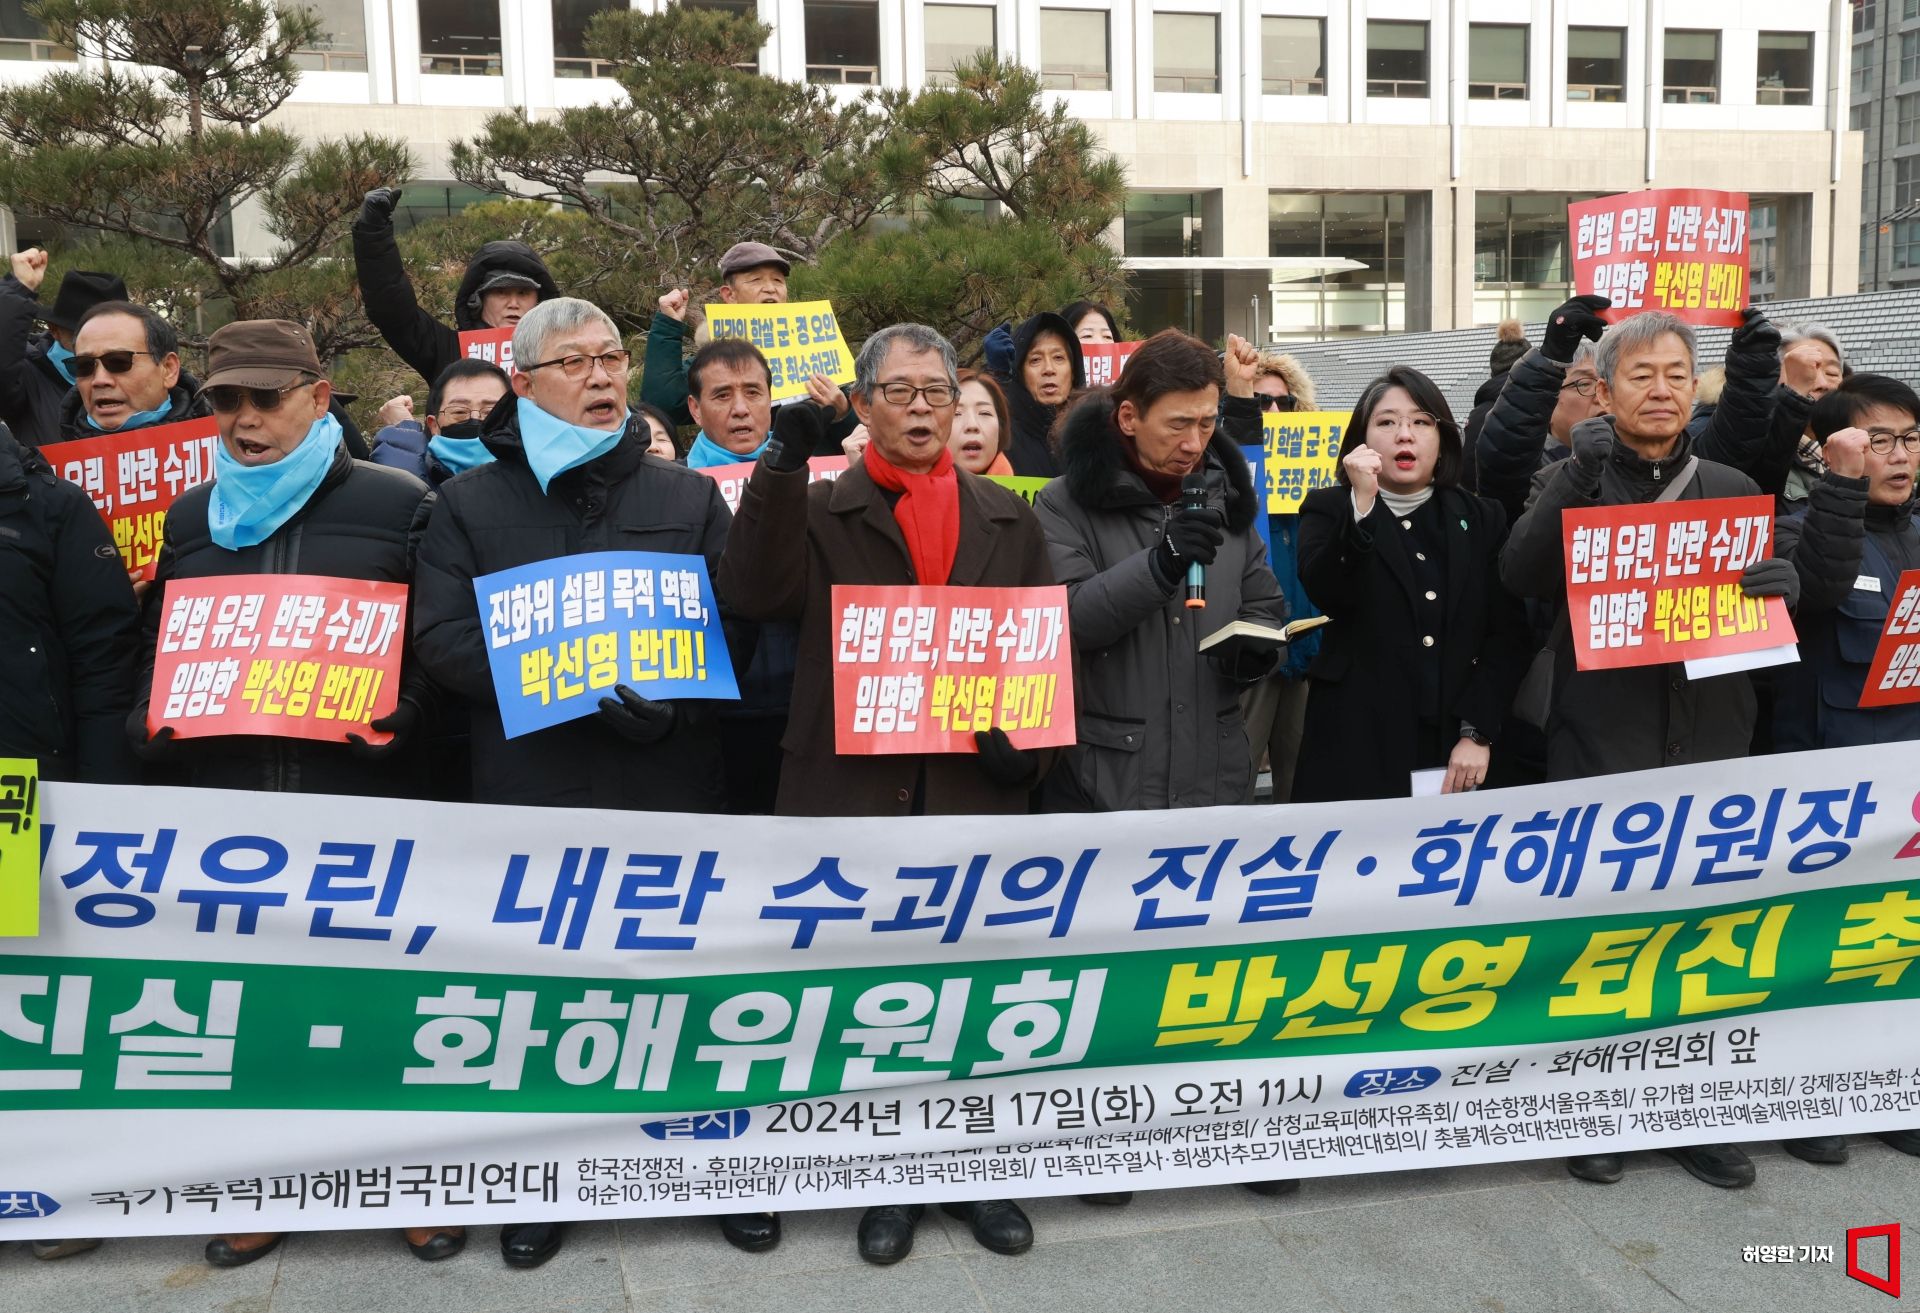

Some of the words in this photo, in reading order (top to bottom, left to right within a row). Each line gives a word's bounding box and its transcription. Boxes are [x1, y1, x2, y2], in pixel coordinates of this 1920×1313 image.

[1577, 212, 1615, 260] 헌법
[1618, 207, 1660, 258] 유린,
[1665, 206, 1702, 251] 반란
[1703, 207, 1746, 255] 수괴가
[1593, 260, 1649, 309] 임명한
[1653, 262, 1705, 309] 박선영
[1705, 263, 1743, 311] 반대!
[811, 313, 838, 343] 오인
[1277, 426, 1305, 458] 학살
[118, 447, 159, 506] 반란
[1277, 468, 1305, 500] 주장
[1571, 525, 1611, 584] 헌법
[1614, 523, 1660, 586] 유린,
[1665, 520, 1708, 576] 반란
[1709, 515, 1770, 573] 수괴가
[161, 595, 215, 653] 헌법
[211, 594, 265, 654] 유린,
[267, 595, 326, 649] 반란
[324, 599, 401, 657] 수괴가
[489, 578, 556, 649] 진화위
[561, 570, 606, 628] 설립
[612, 568, 655, 619] 목적
[660, 569, 708, 627] 역행,
[838, 603, 887, 663] 헌법
[889, 606, 940, 670] 유린,
[946, 607, 993, 663] 반란
[995, 606, 1063, 663] 수괴가
[1589, 588, 1648, 650] 임명한
[1654, 585, 1711, 643] 박선영
[163, 656, 240, 719] 임명한
[242, 659, 321, 717] 박선영
[315, 664, 384, 724] 반대!
[520, 631, 618, 706] 박선영
[629, 629, 707, 681] 반대!
[853, 672, 925, 733] 임명한
[930, 674, 997, 732] 박선영
[999, 673, 1057, 731] 반대!
[39, 823, 437, 955] 정유린,
[492, 847, 725, 950] 내란
[759, 848, 1101, 950] 수괴의
[1154, 935, 1531, 1047] 박선영
[1549, 904, 1794, 1020] 퇴진
[1727, 1026, 1761, 1065] 앞
[766, 1100, 901, 1137] 2024년
[918, 1094, 996, 1134] 12월
[1010, 1084, 1156, 1129] 17일(화)
[1170, 1079, 1243, 1117] 오전
[1258, 1074, 1322, 1107] 11시
[1263, 1100, 1459, 1137] 삼청교육피해자유족회/
[1466, 1088, 1636, 1120] 여순항쟁서울유족회/
[1641, 1083, 1694, 1107] 유가협
[1700, 1076, 1795, 1102] 의문사지회/
[1359, 1070, 1425, 1097] 장소
[577, 1174, 787, 1206] 여순10.19범국민연대/
[795, 1156, 1036, 1194] (사)제주4.3범국민위원회/
[1629, 1098, 1844, 1135] 거창평화인권예술제위원회/
[89, 1162, 559, 1215] 국가폭력피해범국민연대
